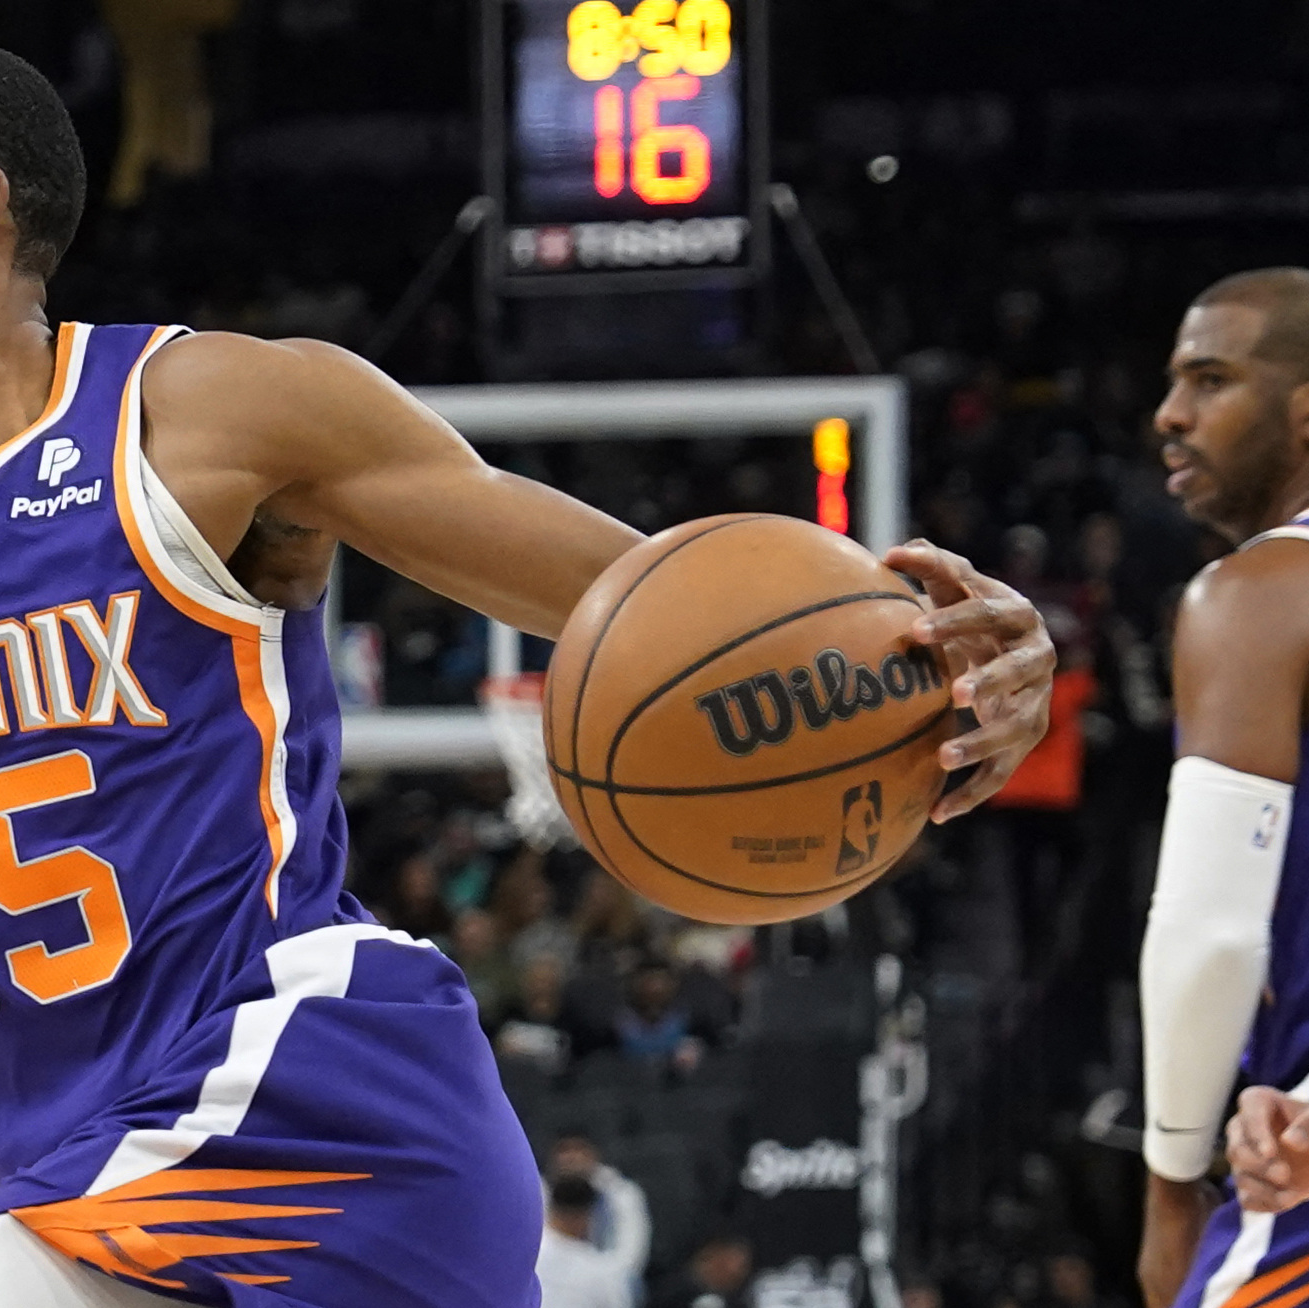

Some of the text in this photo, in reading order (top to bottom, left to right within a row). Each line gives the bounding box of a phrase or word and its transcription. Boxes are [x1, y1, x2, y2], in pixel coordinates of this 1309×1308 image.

[593, 74, 712, 205] 16
[10, 479, 103, 519] PayPal
[693, 648, 943, 757] Wilson
